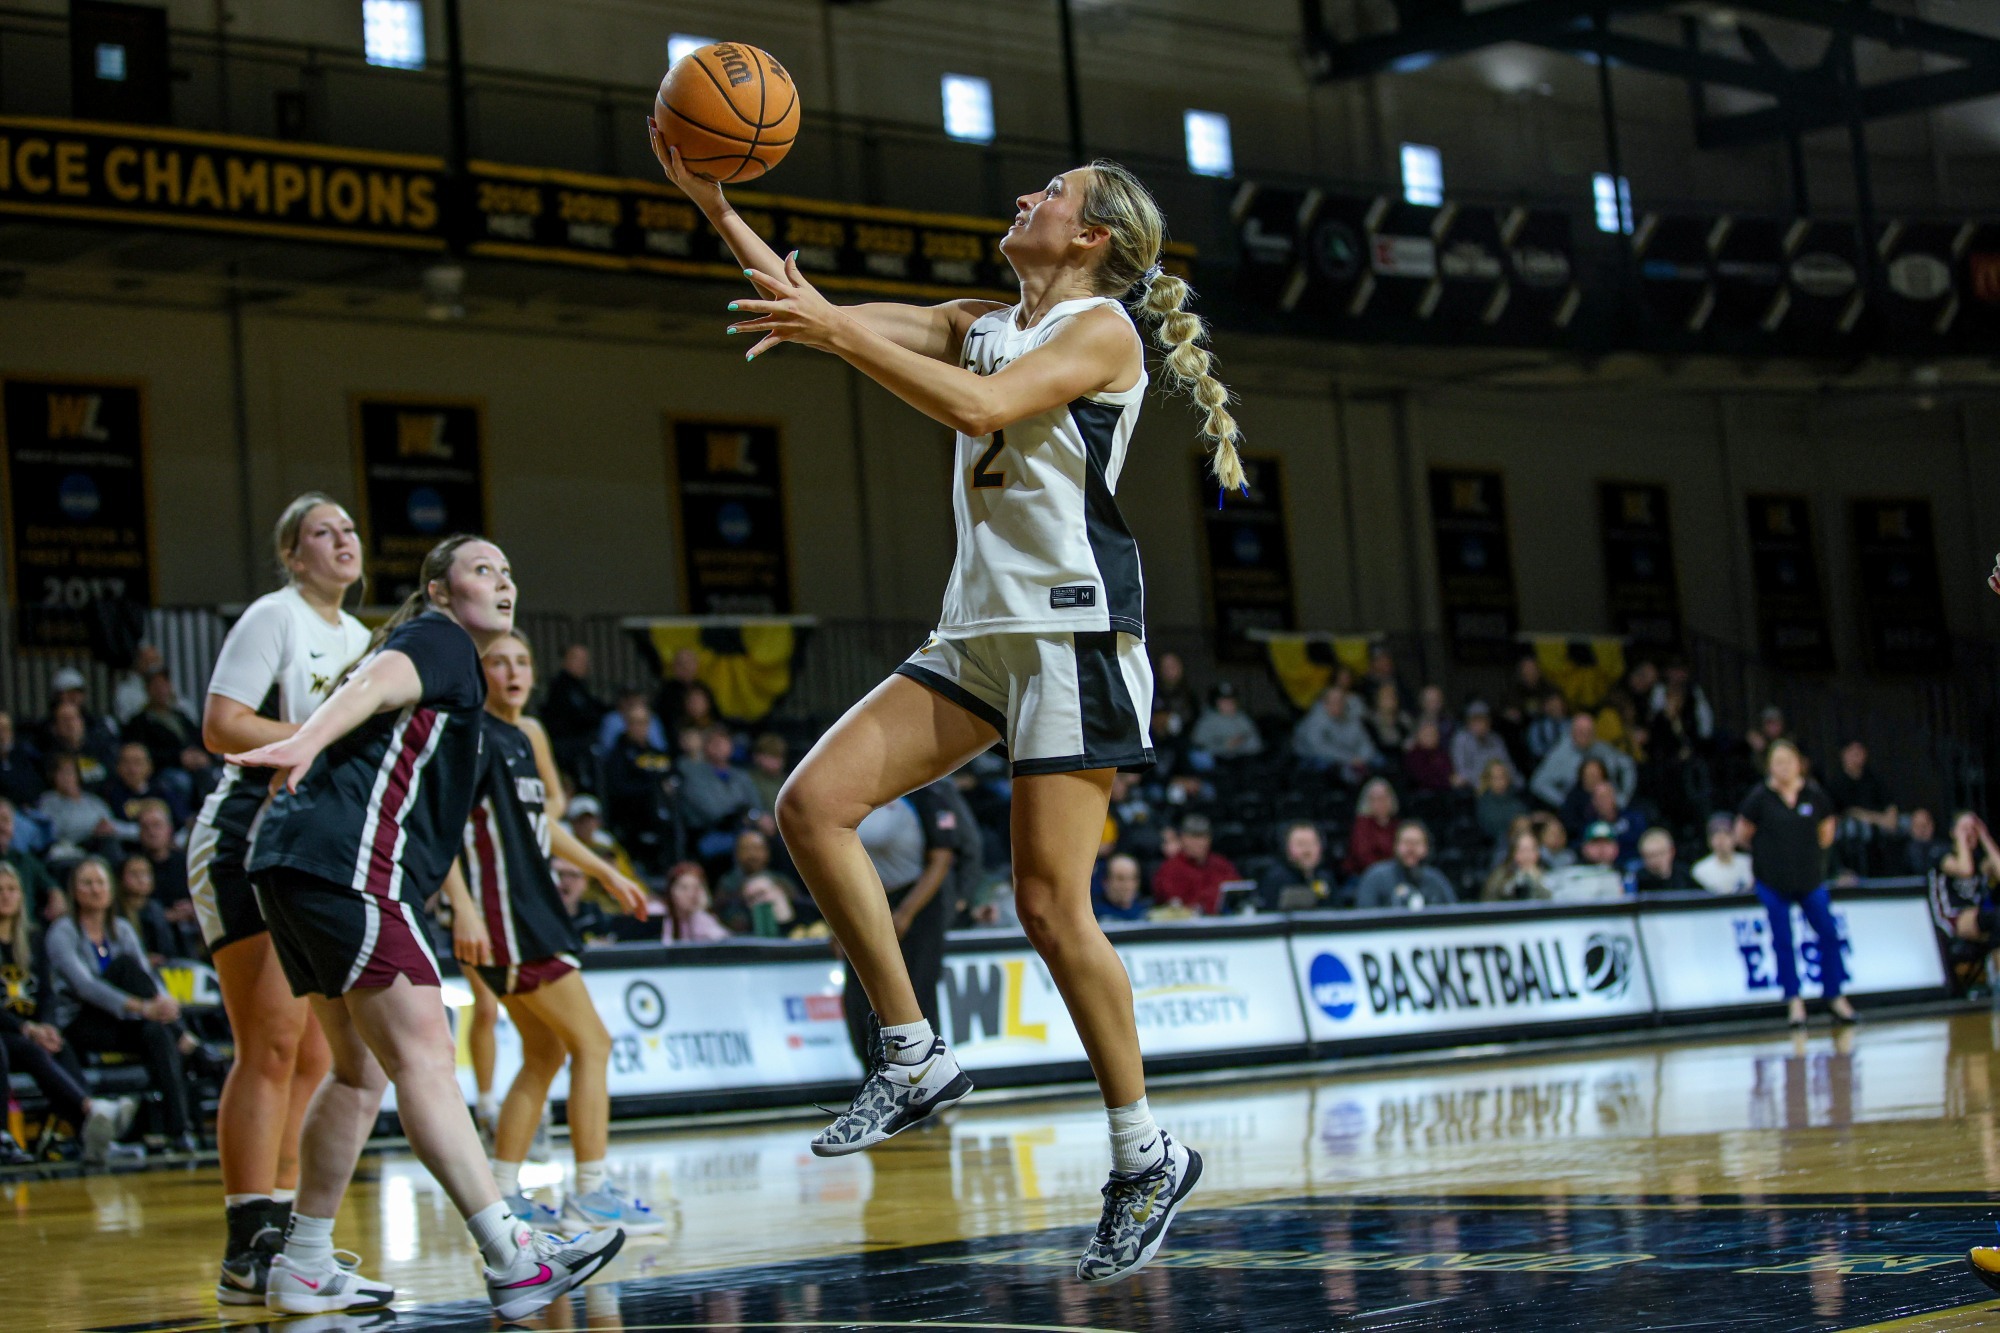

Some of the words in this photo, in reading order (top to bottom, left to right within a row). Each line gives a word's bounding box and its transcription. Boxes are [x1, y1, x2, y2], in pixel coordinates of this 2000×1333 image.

[103, 144, 440, 232] CHAMPIONS
[47, 392, 111, 443] WL
[1081, 591, 1090, 600] M
[941, 958, 1048, 1047] WL
[1360, 939, 1579, 1015] BASKETBALL
